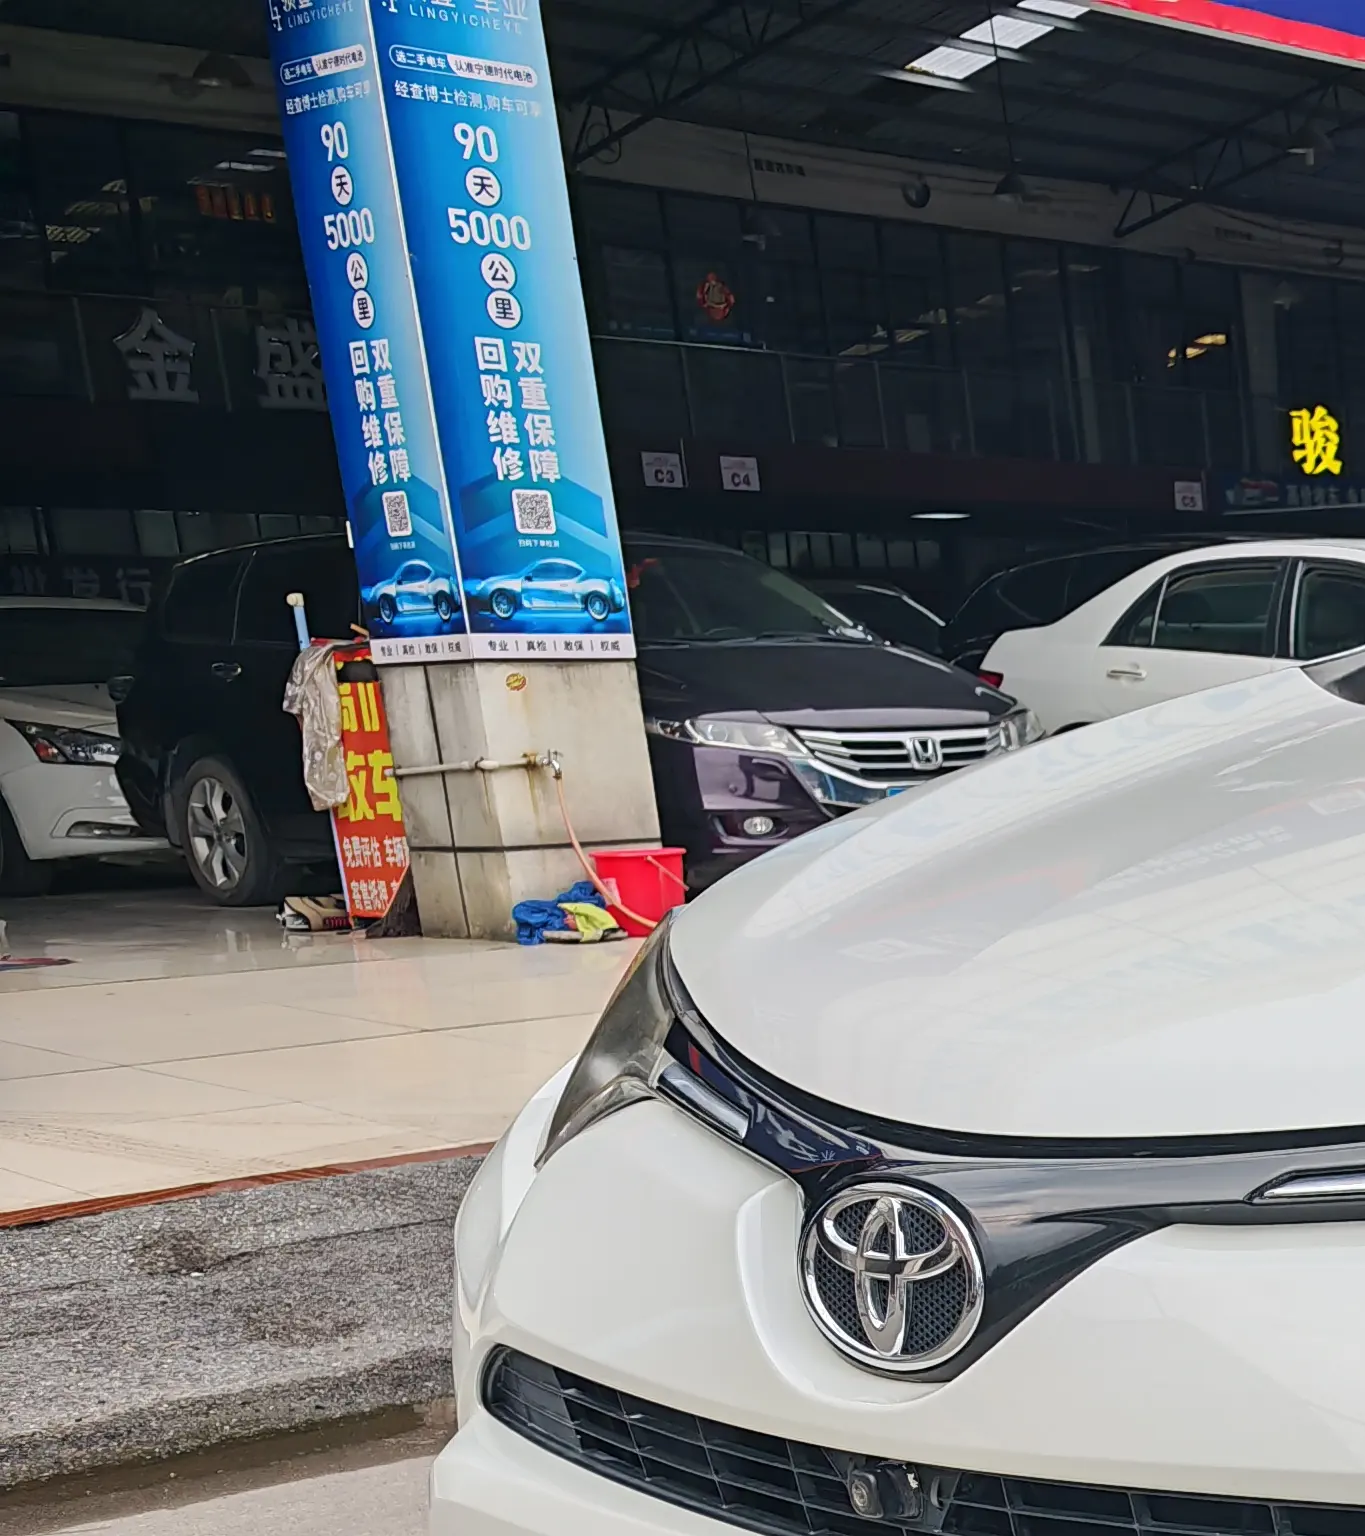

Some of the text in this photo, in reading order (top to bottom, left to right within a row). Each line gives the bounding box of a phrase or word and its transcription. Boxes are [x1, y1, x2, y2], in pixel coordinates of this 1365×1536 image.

[395, 50, 533, 82] 选二手电车 认准宁德时代电池
[321, 121, 348, 162] 90
[454, 122, 499, 163] 90
[324, 207, 374, 250] 5000
[447, 207, 531, 250] 5000
[348, 339, 389, 487] 回购维修
[369, 338, 412, 484] 双重保障
[473, 335, 525, 482] 回购维修
[511, 340, 562, 484] 双重保障
[653, 469, 675, 483] C3
[730, 472, 752, 487] C4
[487, 640, 509, 652] 专业
[600, 640, 621, 652] 权威
[343, 836, 383, 869] 免费评估
